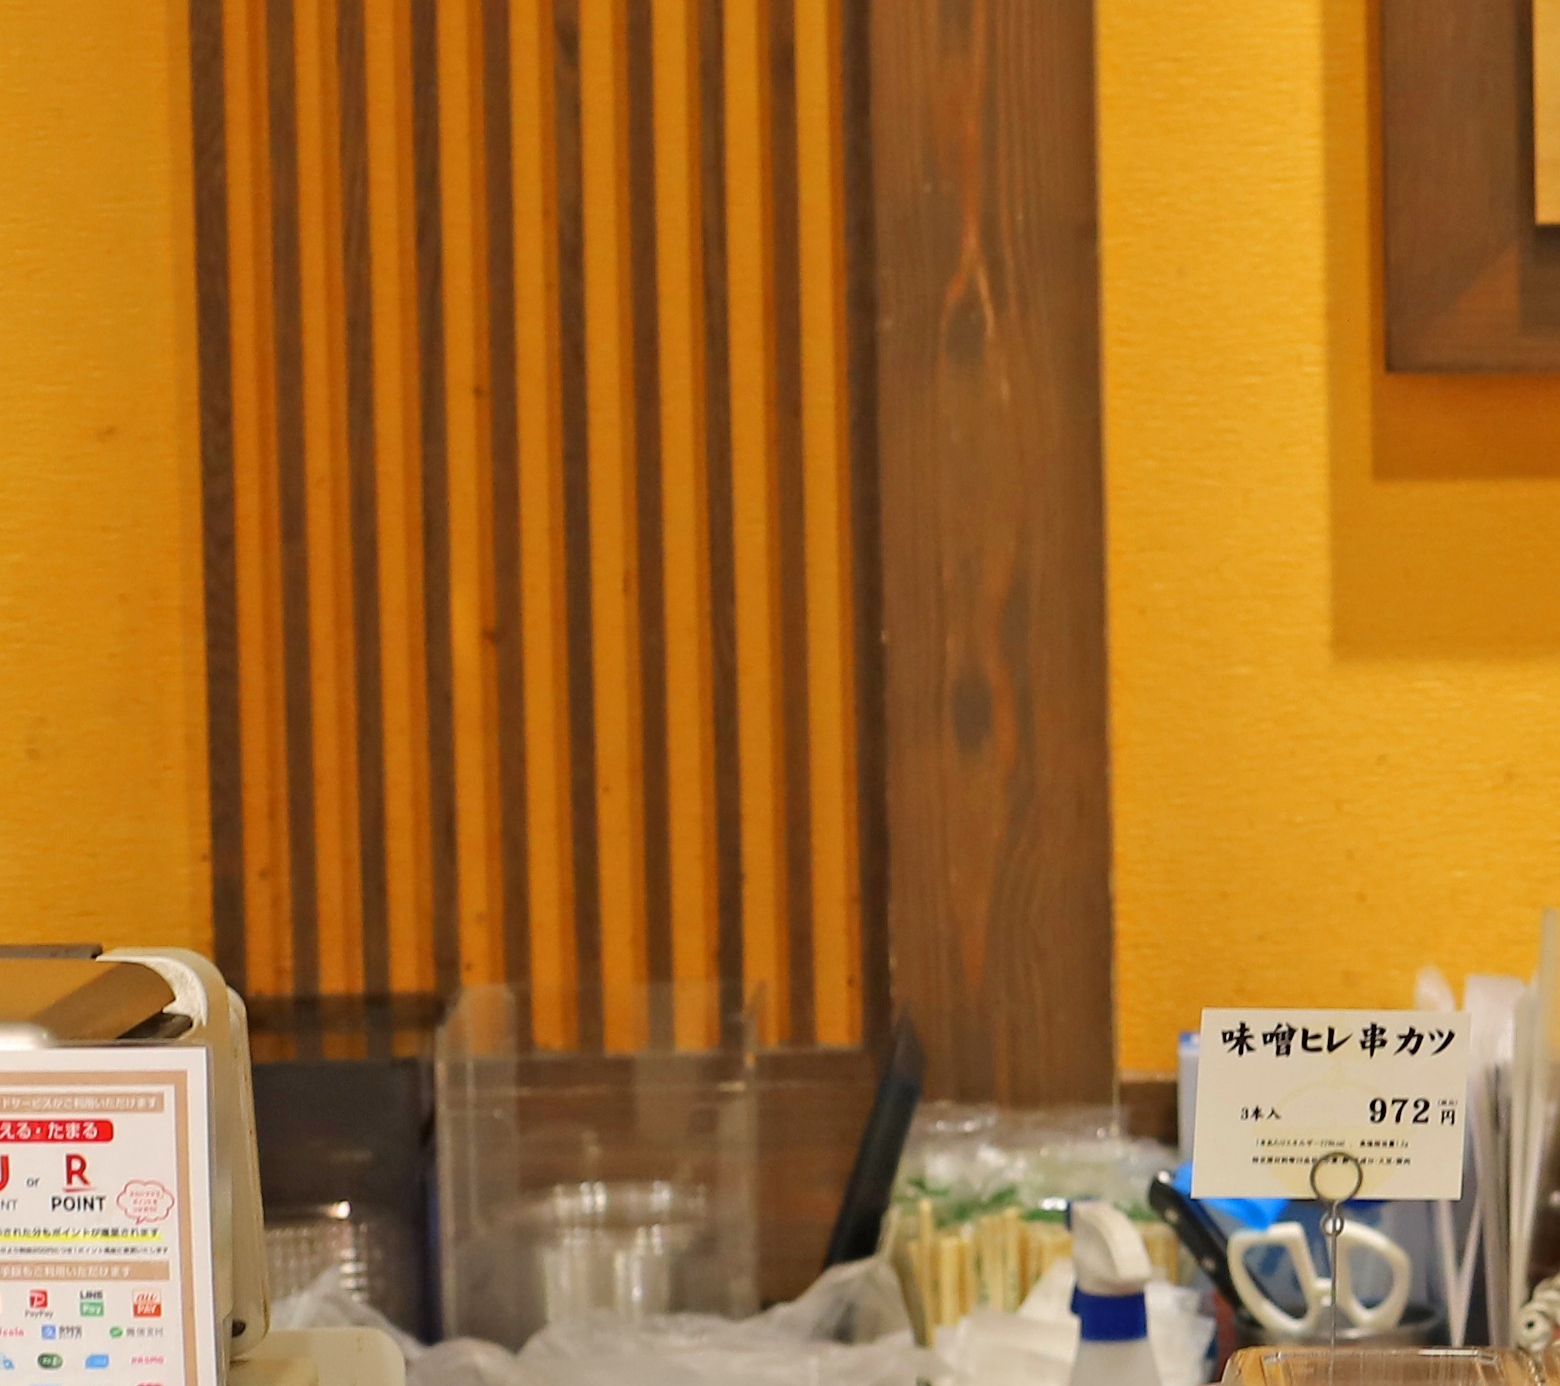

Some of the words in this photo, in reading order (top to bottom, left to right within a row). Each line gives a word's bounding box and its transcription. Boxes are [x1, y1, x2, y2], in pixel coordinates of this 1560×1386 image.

[1221, 1021, 1456, 1058] 味噌ヒレ串カツ
[1369, 1098, 1431, 1125] 972
[51, 1196, 107, 1212] POINT
